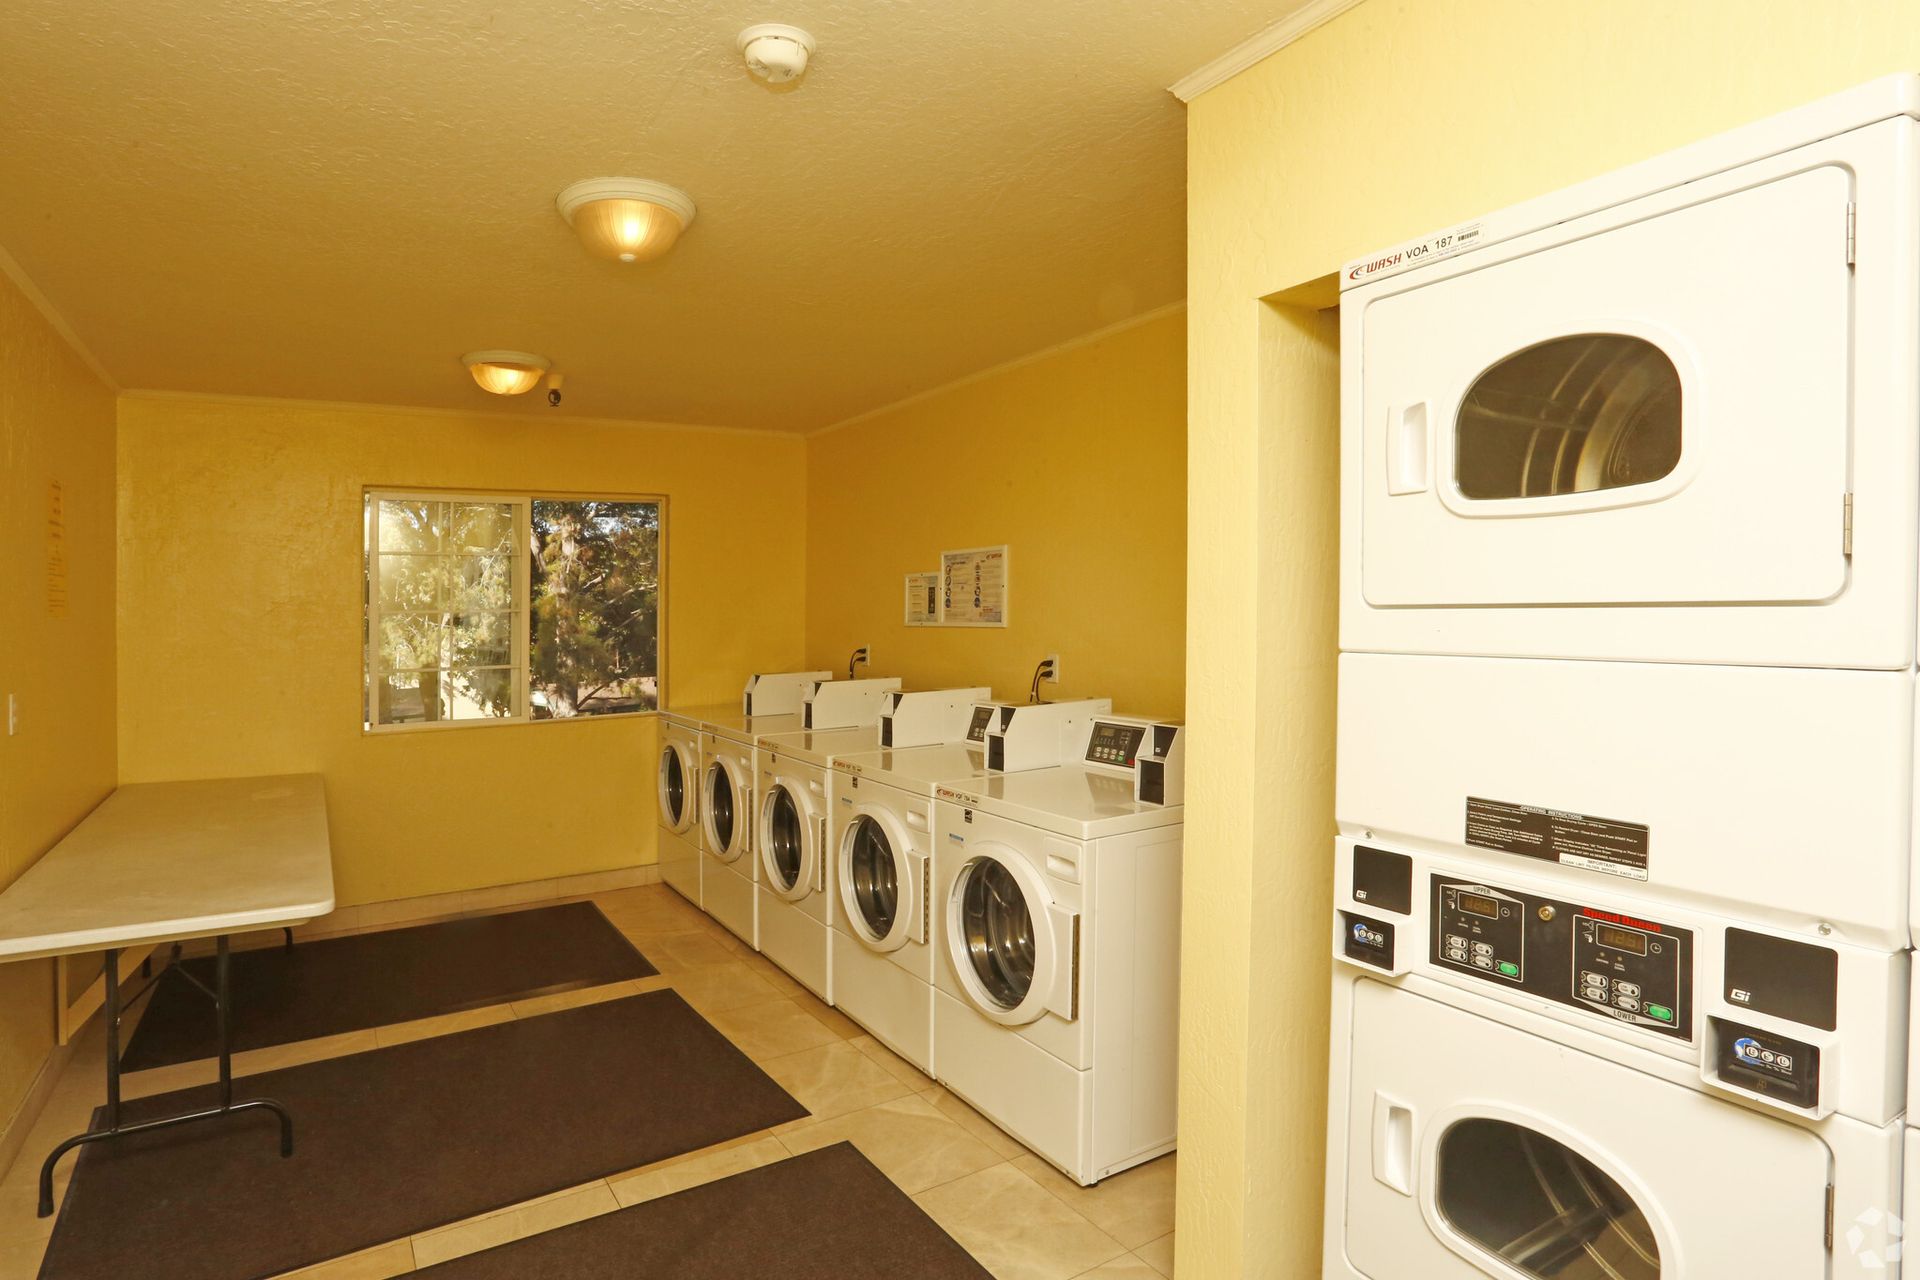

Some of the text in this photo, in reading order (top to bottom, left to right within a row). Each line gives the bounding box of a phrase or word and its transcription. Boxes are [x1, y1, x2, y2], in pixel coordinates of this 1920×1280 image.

[1366, 253, 1402, 273] WASH
[1406, 244, 1429, 259] VOA
[1435, 235, 1453, 249] 187
[1473, 886, 1491, 895] UPPER
[1583, 907, 1662, 932] Speed Queen
[1731, 989, 1751, 1002] Gi
[1613, 1010, 1636, 1022] LOWER
